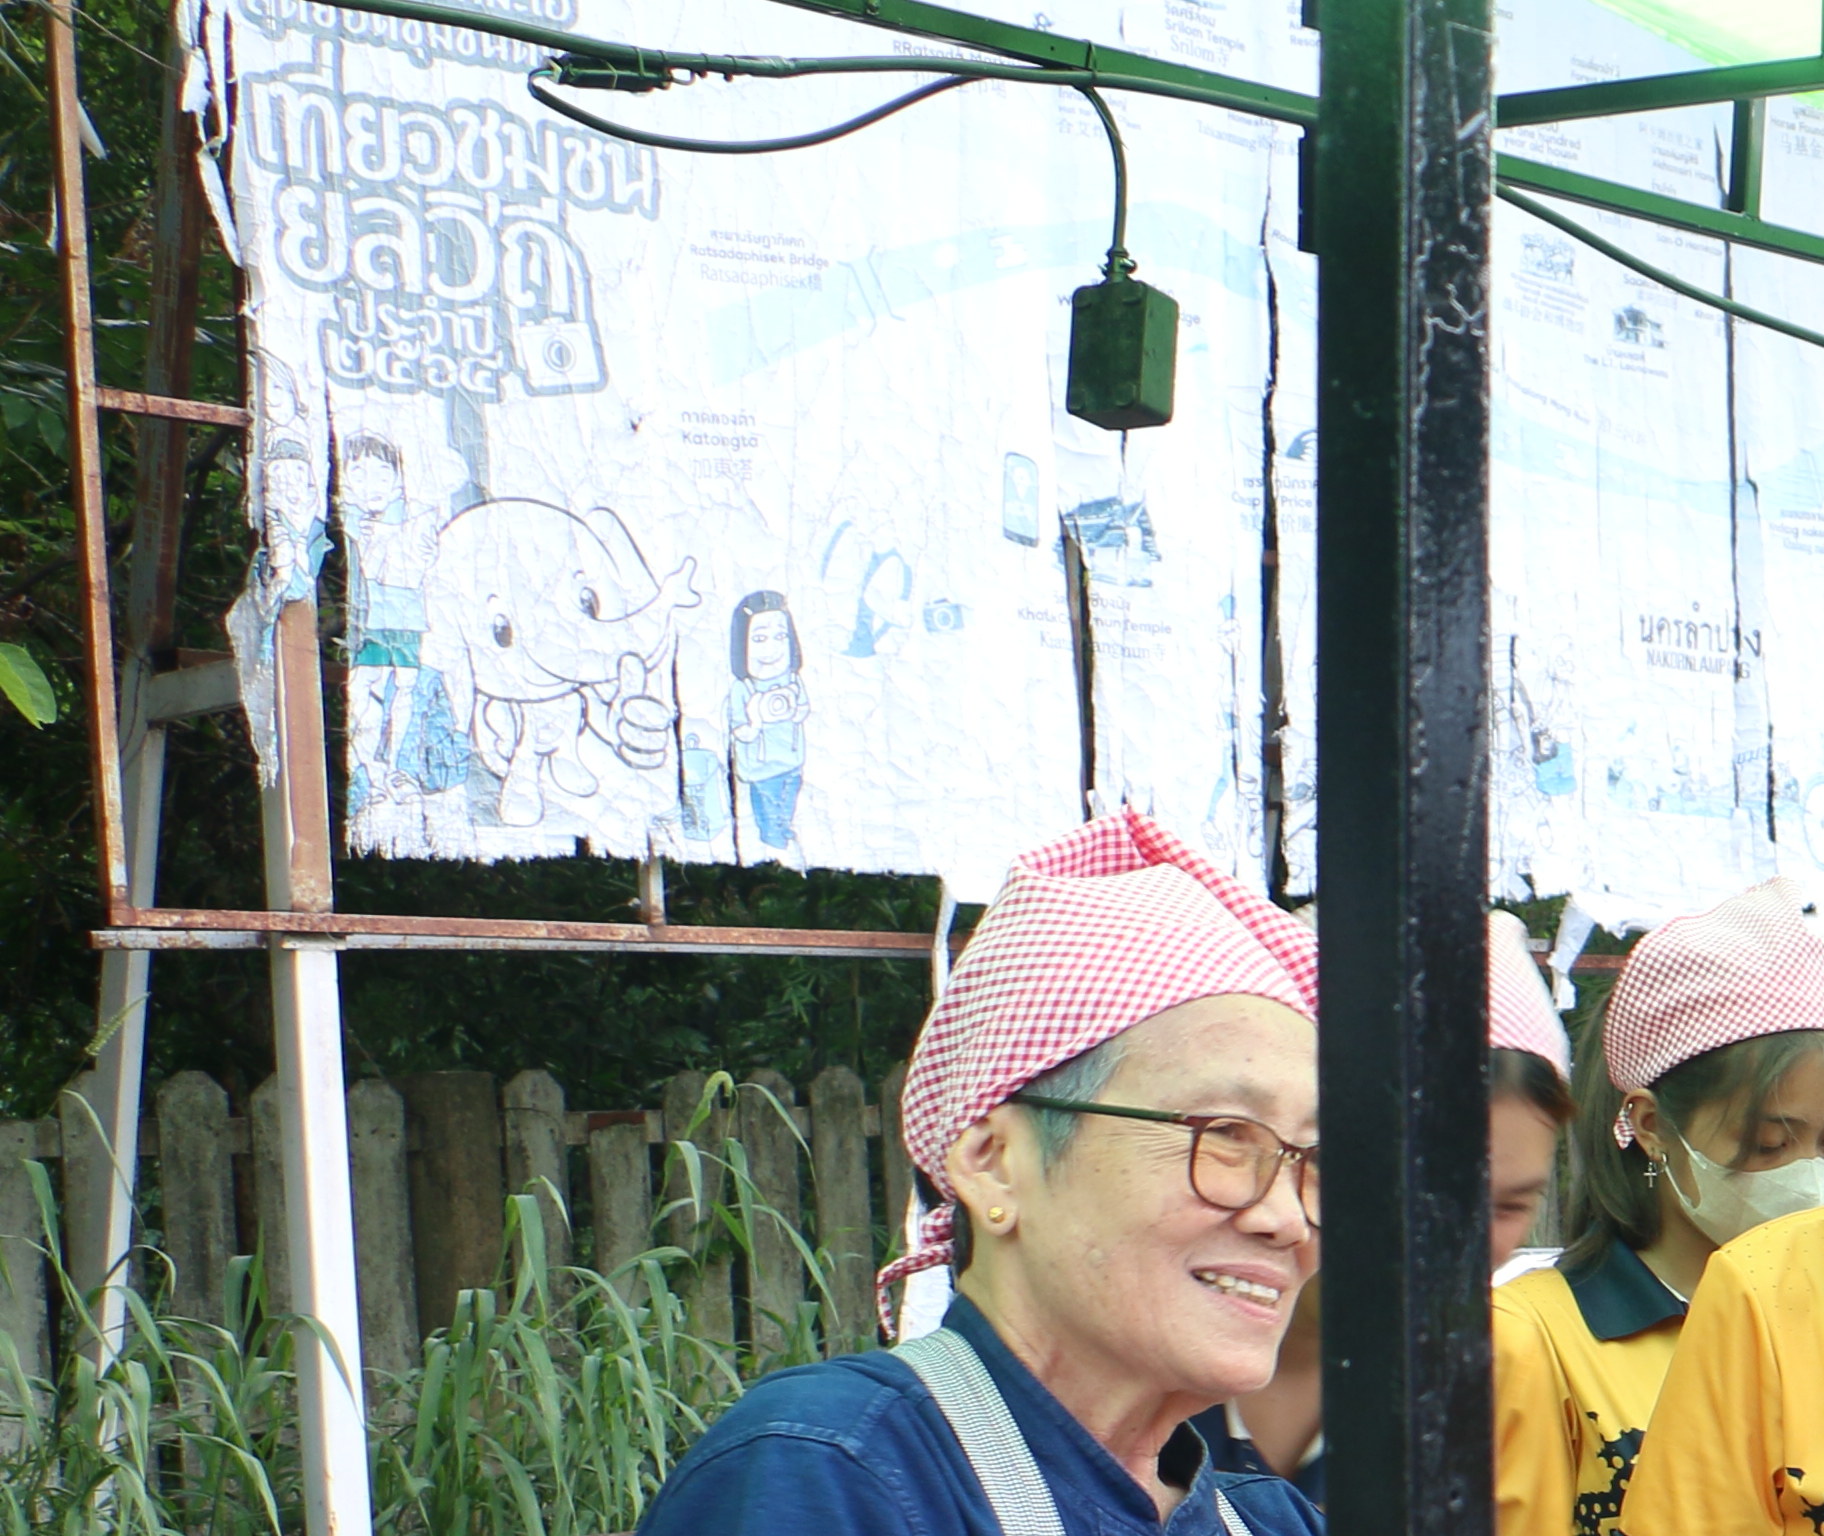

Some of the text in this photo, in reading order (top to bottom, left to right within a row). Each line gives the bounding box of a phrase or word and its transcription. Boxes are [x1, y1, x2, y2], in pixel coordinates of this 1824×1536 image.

[1206, 28, 1246, 52] Temple
[789, 252, 830, 272] Bridge
[681, 430, 759, 453] Katongta
[1280, 494, 1313, 509] Price
[1638, 600, 1763, 658] นครลำปง
